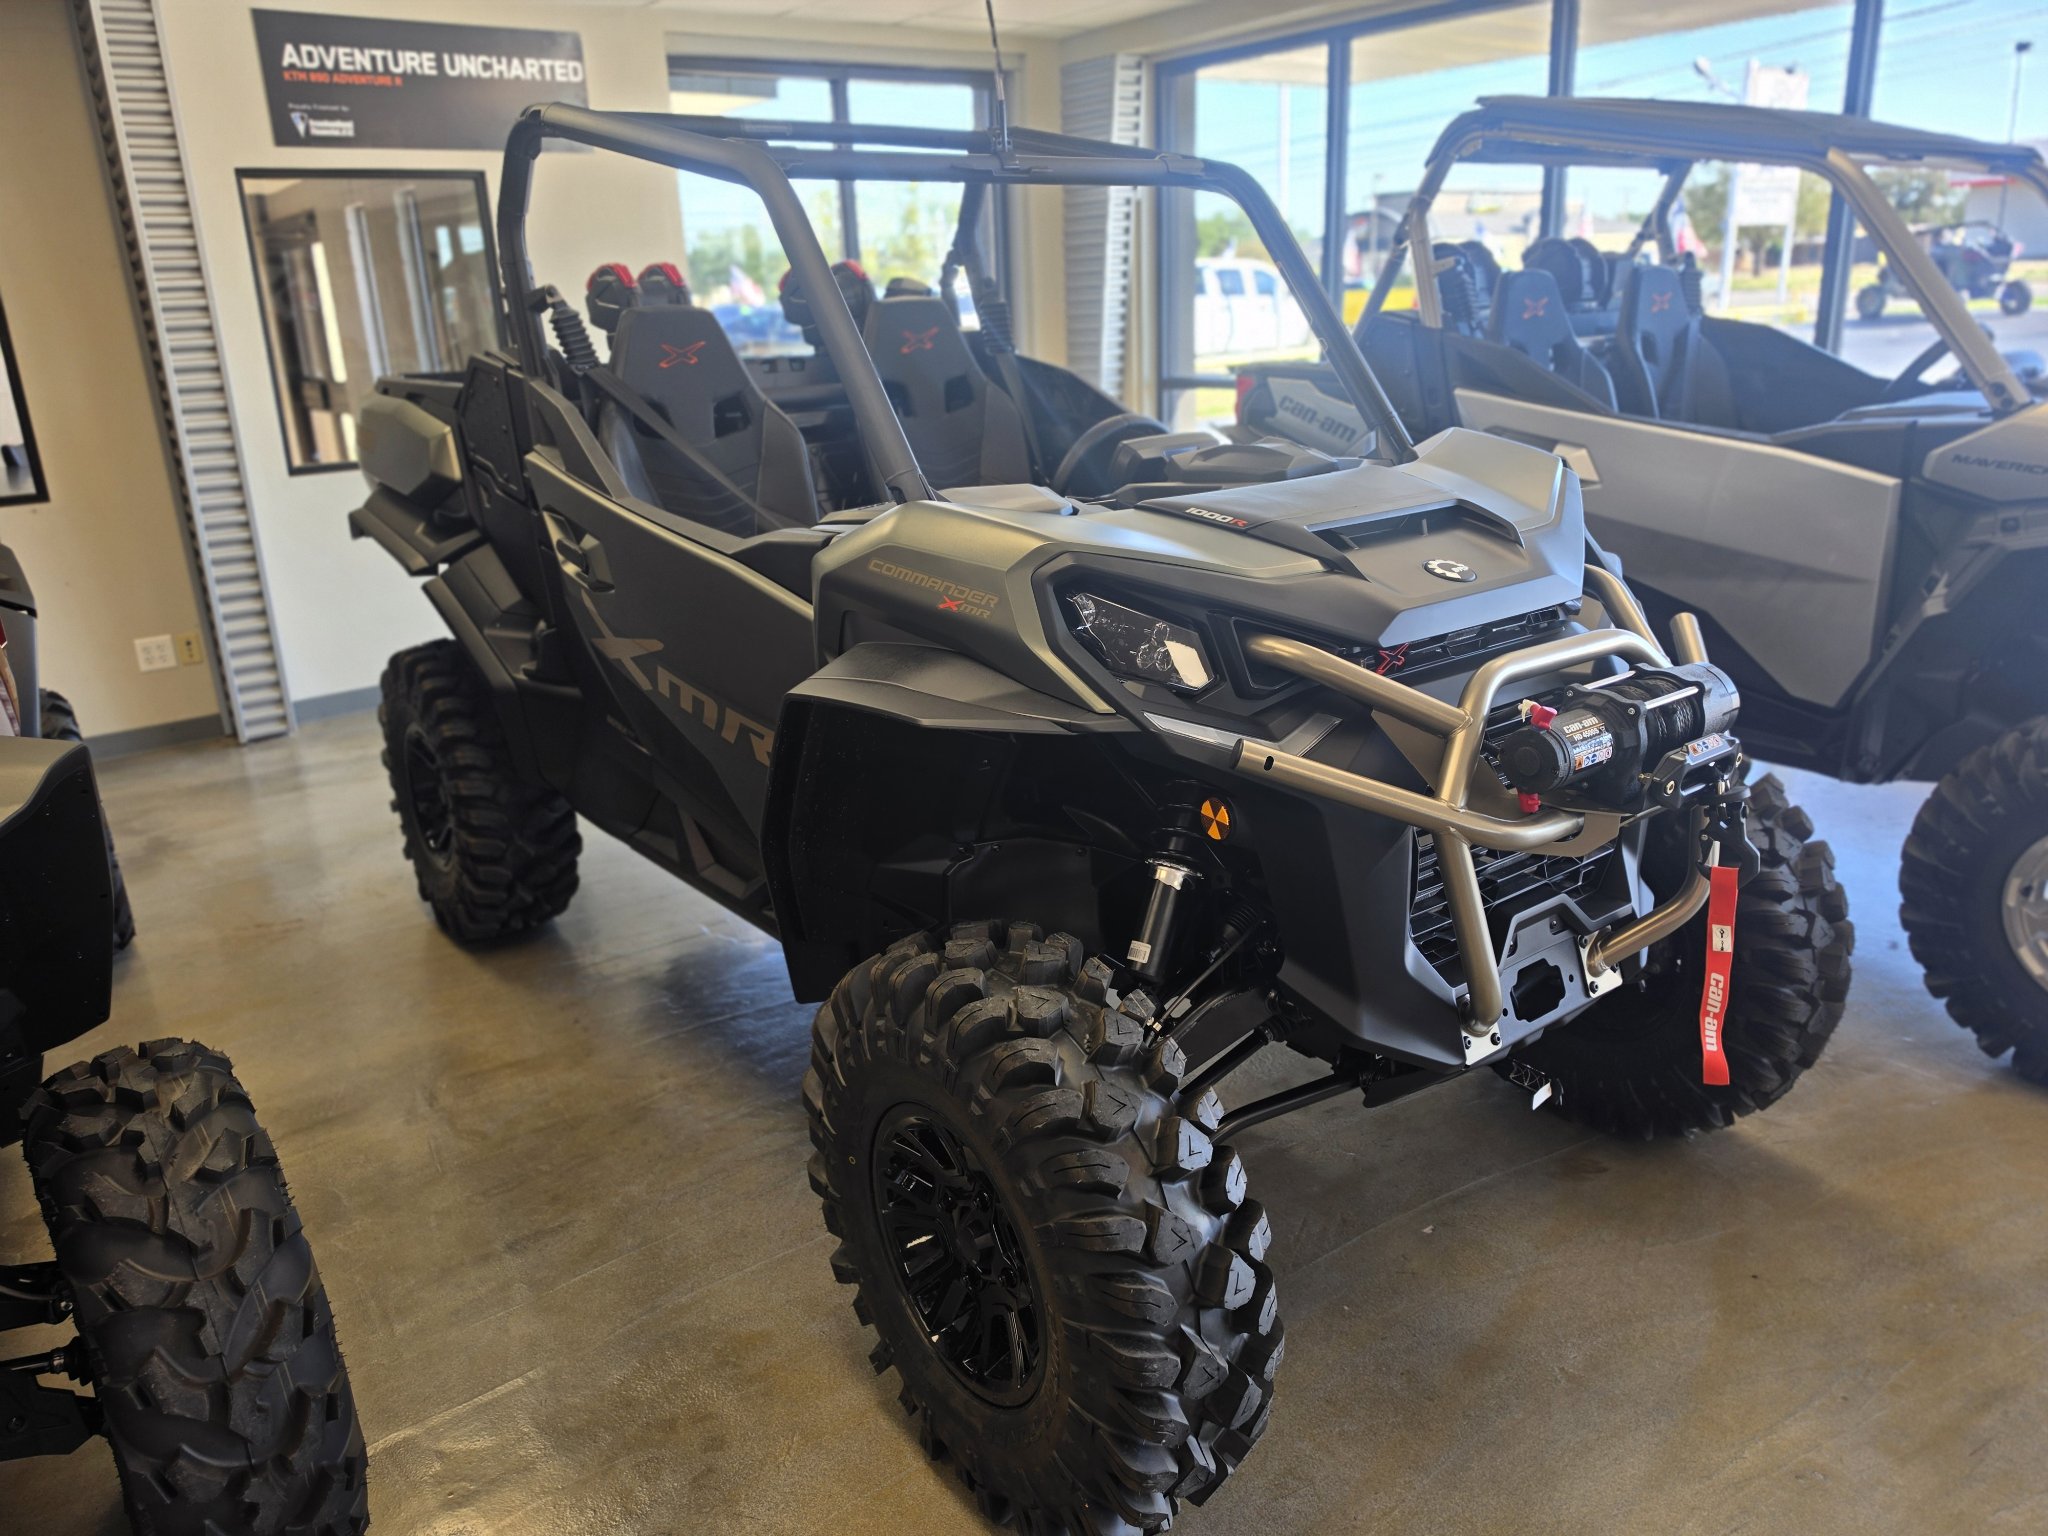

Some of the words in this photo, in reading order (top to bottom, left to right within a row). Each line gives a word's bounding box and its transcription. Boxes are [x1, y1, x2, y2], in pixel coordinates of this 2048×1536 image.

[282, 43, 438, 76] ADVENTURE
[443, 53, 584, 83] UNCHARTED
[1280, 395, 1358, 442] can-am
[1185, 507, 1249, 527] 1000R
[868, 559, 1000, 608] COMMANDER
[1563, 716, 1599, 734] can-am
[1705, 972, 1725, 1051] can-am
